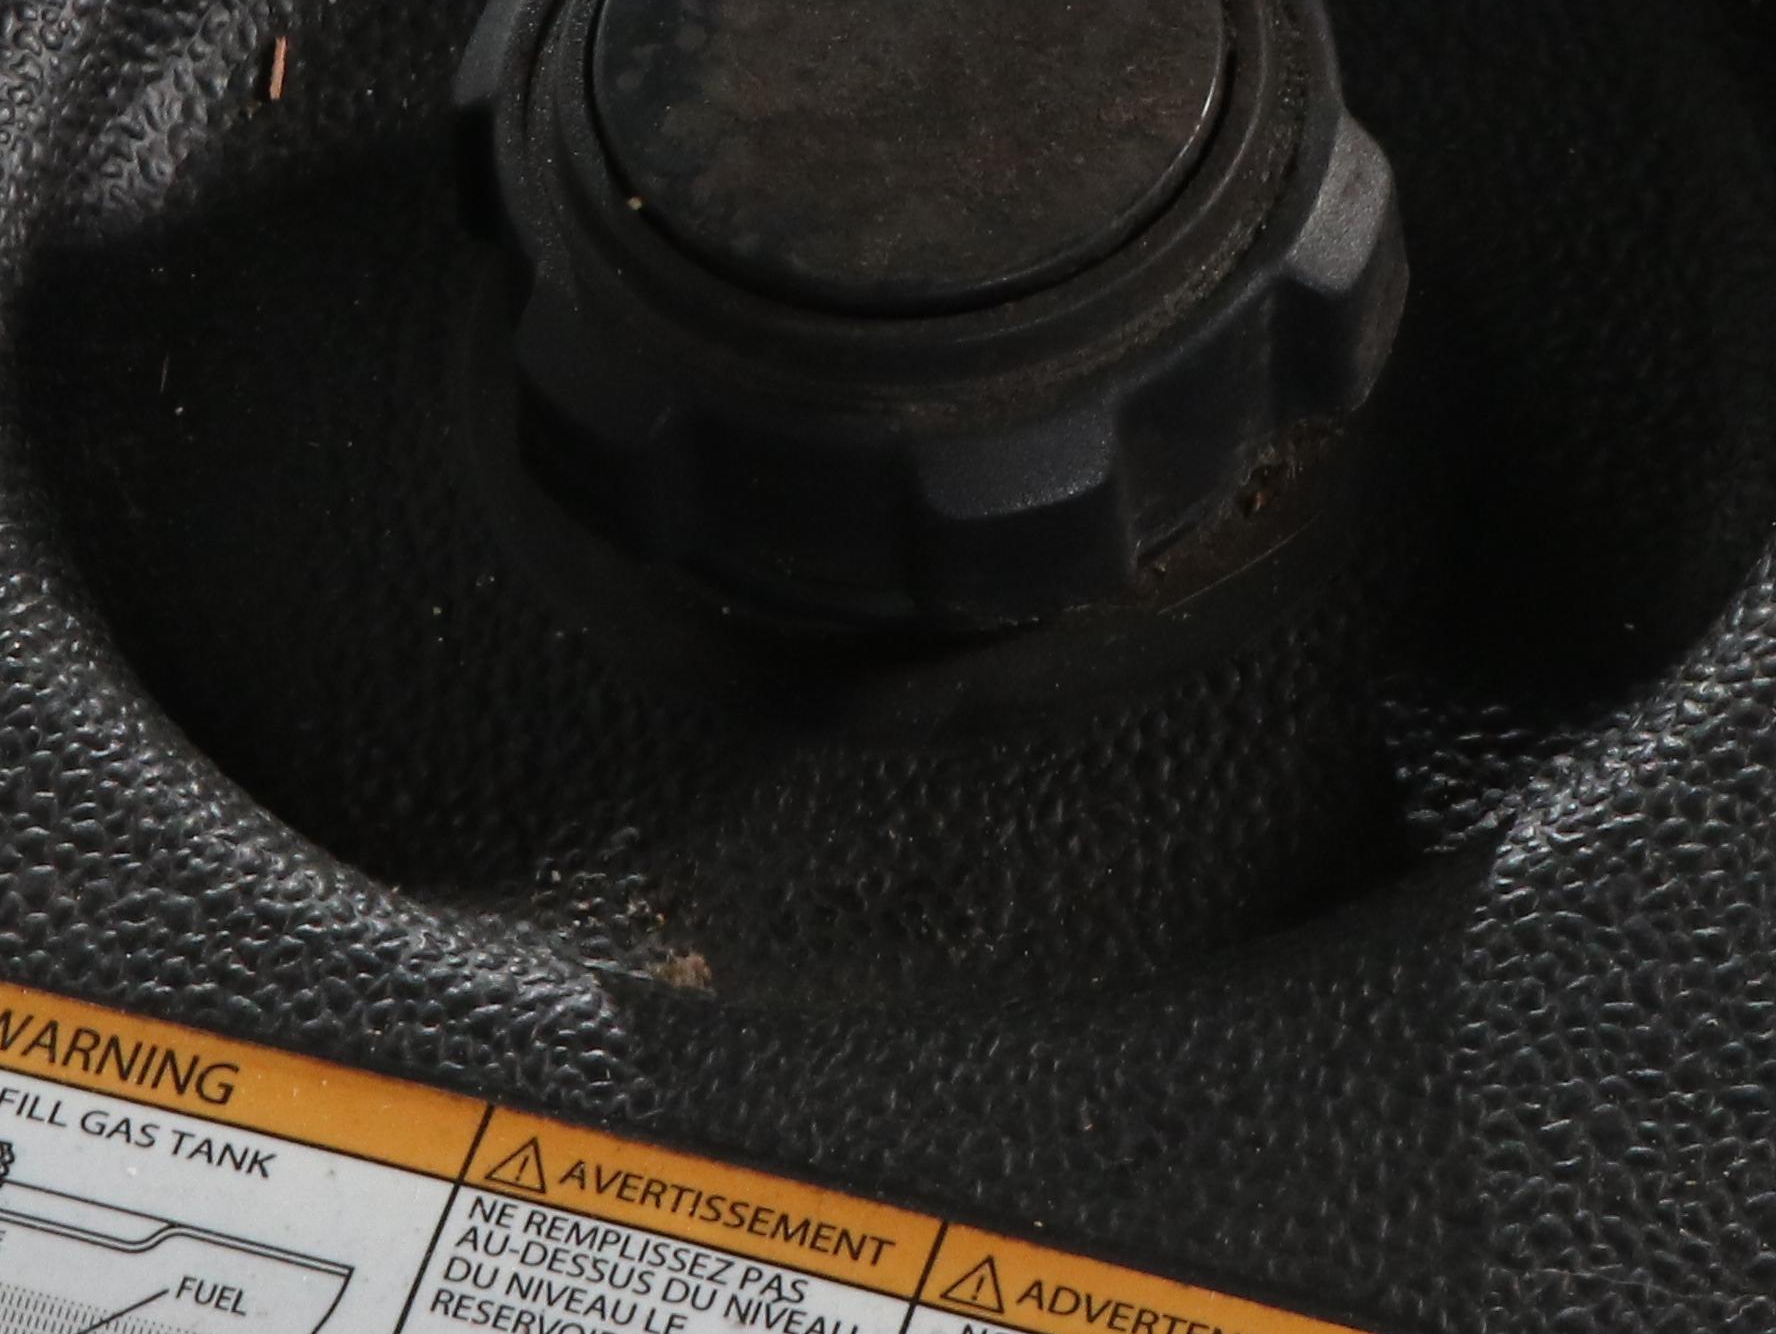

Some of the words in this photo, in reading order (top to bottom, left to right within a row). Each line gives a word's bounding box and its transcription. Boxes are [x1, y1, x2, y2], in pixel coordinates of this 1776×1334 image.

[79, 1109, 160, 1148] GAS
[171, 1129, 276, 1178] TANK
[467, 1195, 518, 1228] NE
[522, 1209, 735, 1285] REMPLISSEZ
[738, 1265, 808, 1304] PAS
[557, 1159, 896, 1267] AVERTISSEMENT
[174, 1275, 246, 1316] FUEL
[442, 1255, 499, 1289] DU
[504, 1271, 637, 1326] NIVEAU
[454, 1225, 655, 1295] AU-DESSUS
[660, 1276, 717, 1311] DU
